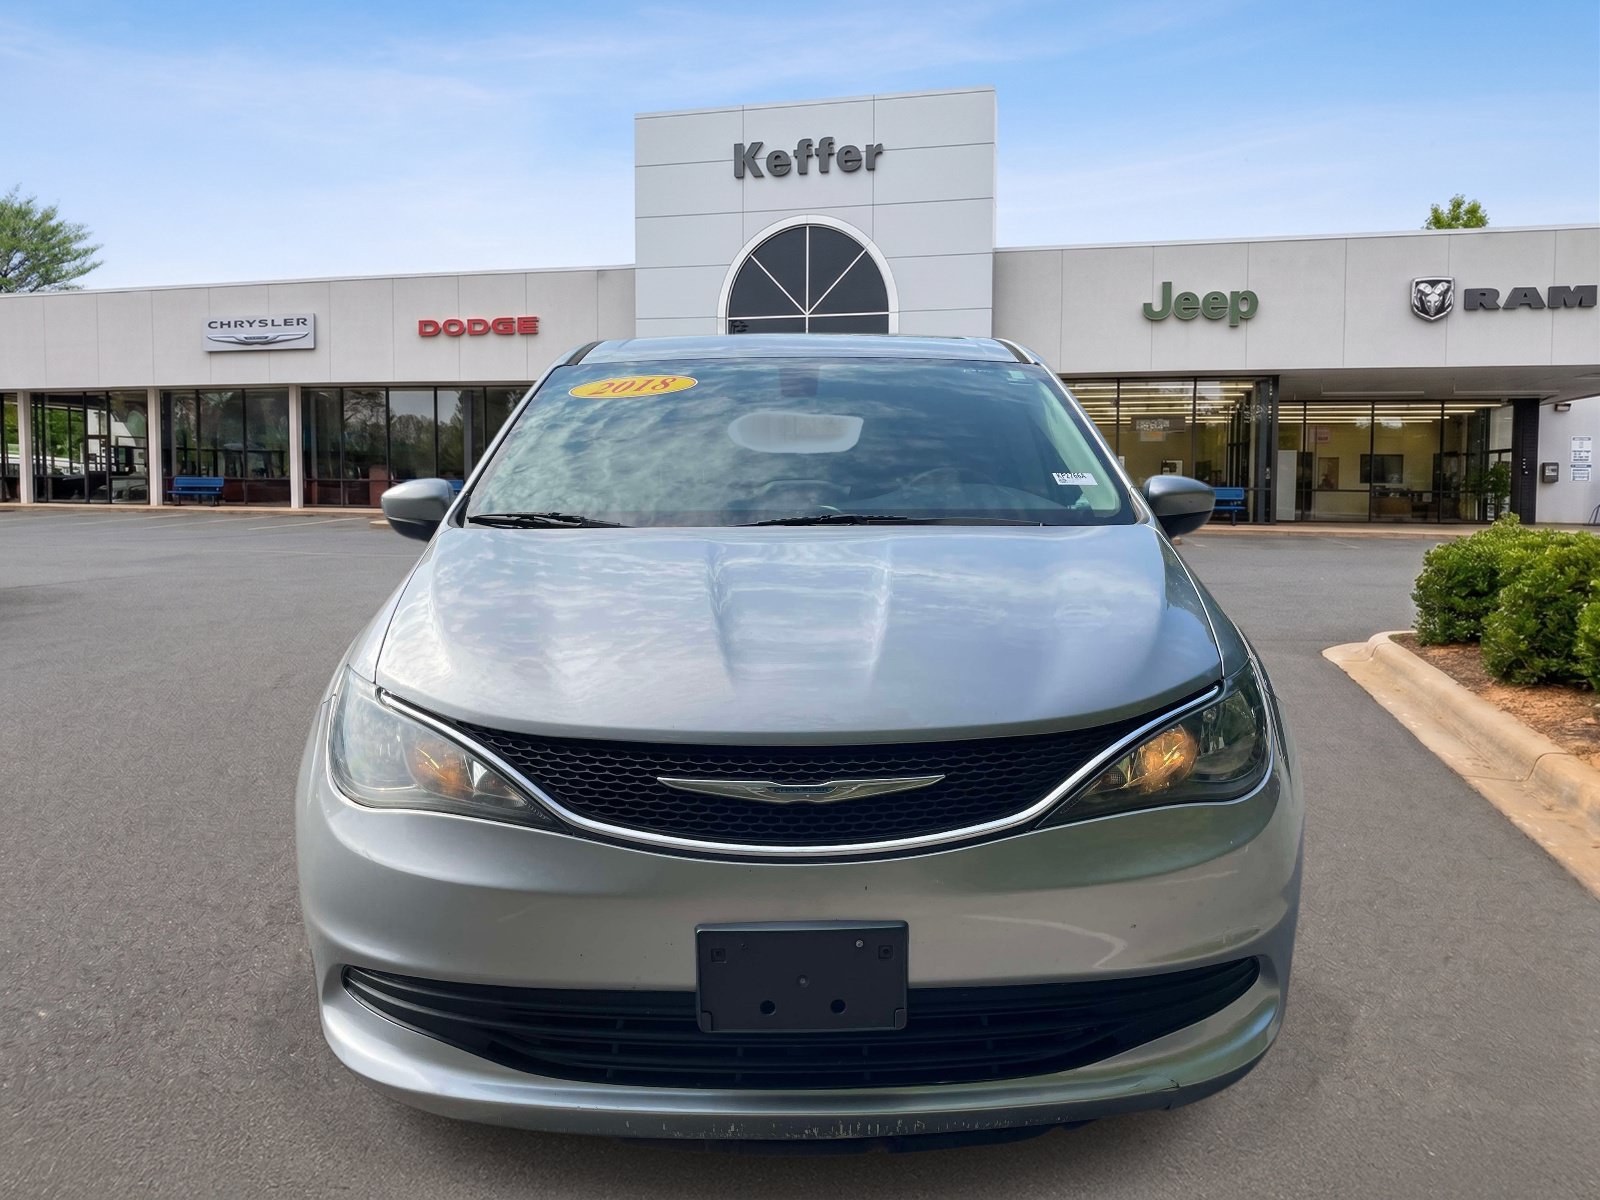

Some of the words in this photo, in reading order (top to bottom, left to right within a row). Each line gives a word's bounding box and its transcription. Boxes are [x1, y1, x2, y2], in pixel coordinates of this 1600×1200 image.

[733, 136, 883, 179] Keffer
[1142, 281, 1259, 327] Jeep
[1464, 285, 1598, 311] RAM
[207, 317, 308, 330] CHRYSLER
[418, 316, 539, 337] DODGE
[586, 377, 677, 396] 2018
